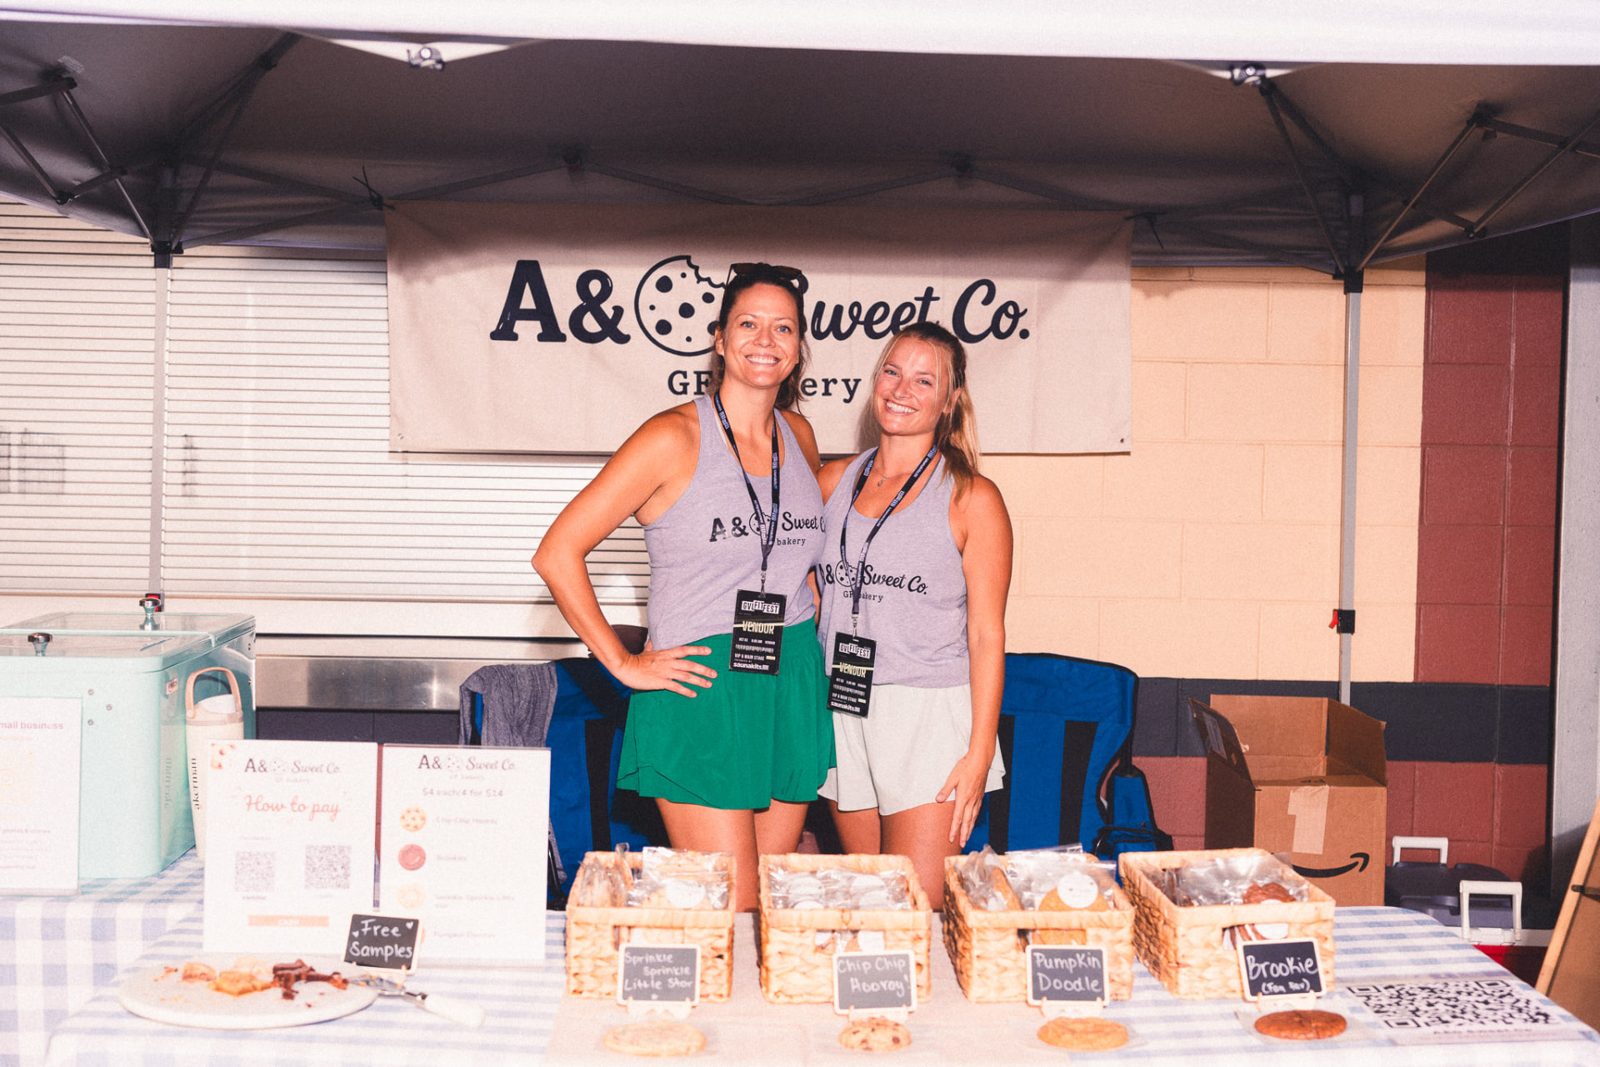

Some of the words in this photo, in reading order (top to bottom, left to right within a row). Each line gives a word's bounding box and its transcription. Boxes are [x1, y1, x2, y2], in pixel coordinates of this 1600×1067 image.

[490, 259, 631, 345] A&
[800, 279, 940, 341] weet
[952, 278, 1031, 344] Co.
[667, 370, 713, 396] GF
[782, 511, 818, 532] Sweet
[776, 537, 806, 546] bakery
[863, 564, 906, 589] Sweet
[907, 575, 928, 596] Co.
[742, 620, 775, 635] VENDOR
[839, 662, 867, 678] VENDOR
[291, 760, 324, 774] Sweet
[465, 757, 499, 771] Sweet
[243, 794, 287, 814] How
[289, 794, 307, 814] to
[308, 801, 342, 823] pay
[361, 918, 402, 937] Free
[349, 941, 413, 963] Samples
[1037, 972, 1103, 993] Doodle
